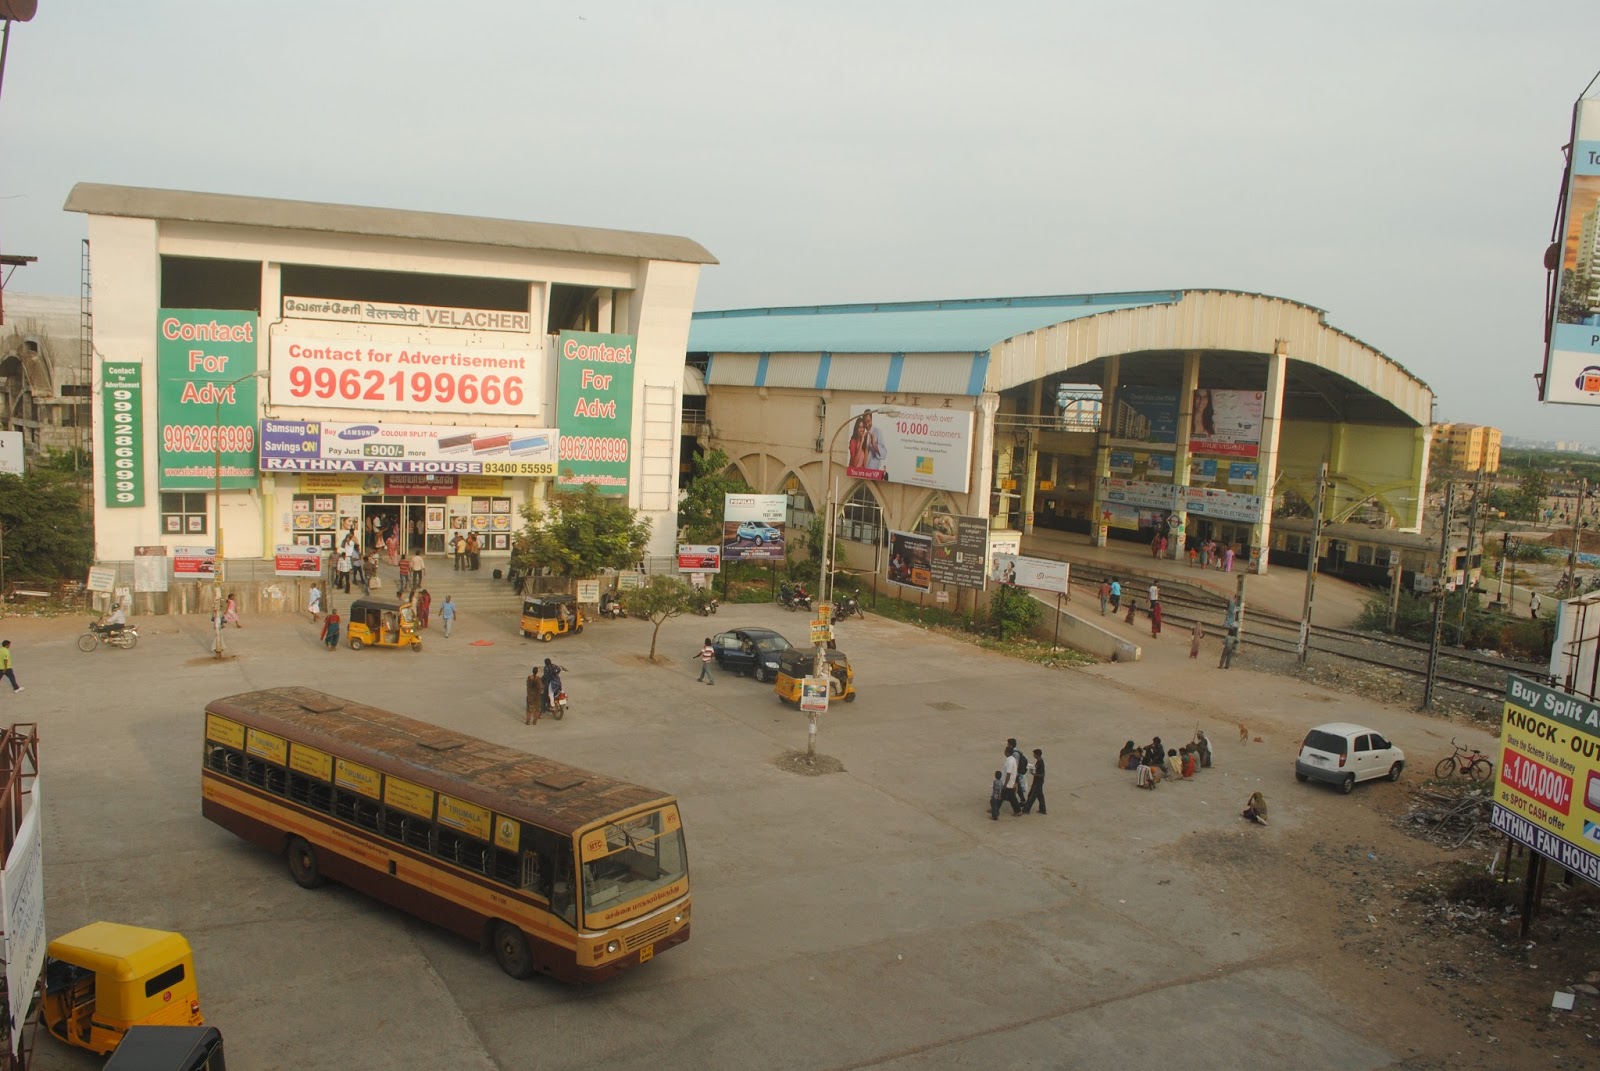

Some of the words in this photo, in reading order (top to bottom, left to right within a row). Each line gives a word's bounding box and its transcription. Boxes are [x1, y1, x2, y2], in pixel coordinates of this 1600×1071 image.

[163, 318, 253, 342] Contact
[426, 309, 529, 330] VELACHERI
[188, 350, 229, 372] For
[288, 344, 362, 363] Contact
[367, 348, 393, 363] for
[398, 350, 526, 370] Advertisement
[564, 339, 632, 364] Contact
[108, 367, 136, 375] Contact
[582, 369, 612, 390] For
[105, 381, 140, 389] Advertisement
[181, 382, 236, 404] Advt
[289, 365, 524, 406] 9962199666
[574, 398, 616, 419] Advt
[163, 425, 254, 453] 9962866999
[266, 422, 305, 435] Samsung
[306, 424, 319, 435] ON
[324, 428, 337, 437] Buy
[342, 428, 376, 437] SAMSUNG
[381, 430, 408, 438] COLOUR
[896, 421, 928, 435] 10,000
[113, 390, 135, 503] 9962866999
[265, 441, 301, 453] Savings
[328, 447, 342, 456] Pay
[559, 436, 628, 462] 9962866999
[267, 458, 357, 471] RATHNA
[363, 461, 403, 472] FAN
[410, 463, 481, 474] HOUSE
[485, 463, 517, 474] 93400
[521, 463, 553, 474] 55595
[1511, 680, 1541, 708] Buy
[1543, 692, 1583, 722] Split
[1585, 711, 1600, 728] A
[1506, 708, 1559, 744] KNOCK
[1570, 735, 1600, 762] OUT
[1507, 733, 1519, 748] Share
[1526, 742, 1544, 760] Scheme
[1545, 749, 1559, 766] Value
[1559, 755, 1576, 775] Money
[344, 768, 372, 784] TIRUMALA
[1503, 765, 1513, 780] Rs.
[1513, 756, 1569, 806] 1,00,000/-
[448, 804, 481, 823] TIRUMALA
[1502, 790, 1509, 802] as
[1510, 793, 1528, 812] SPOT
[1528, 803, 1547, 824] CASH
[1548, 814, 1565, 831] offer
[1491, 805, 1535, 845] RATHNA
[1536, 829, 1559, 858] FAN
[589, 840, 603, 850] MTC
